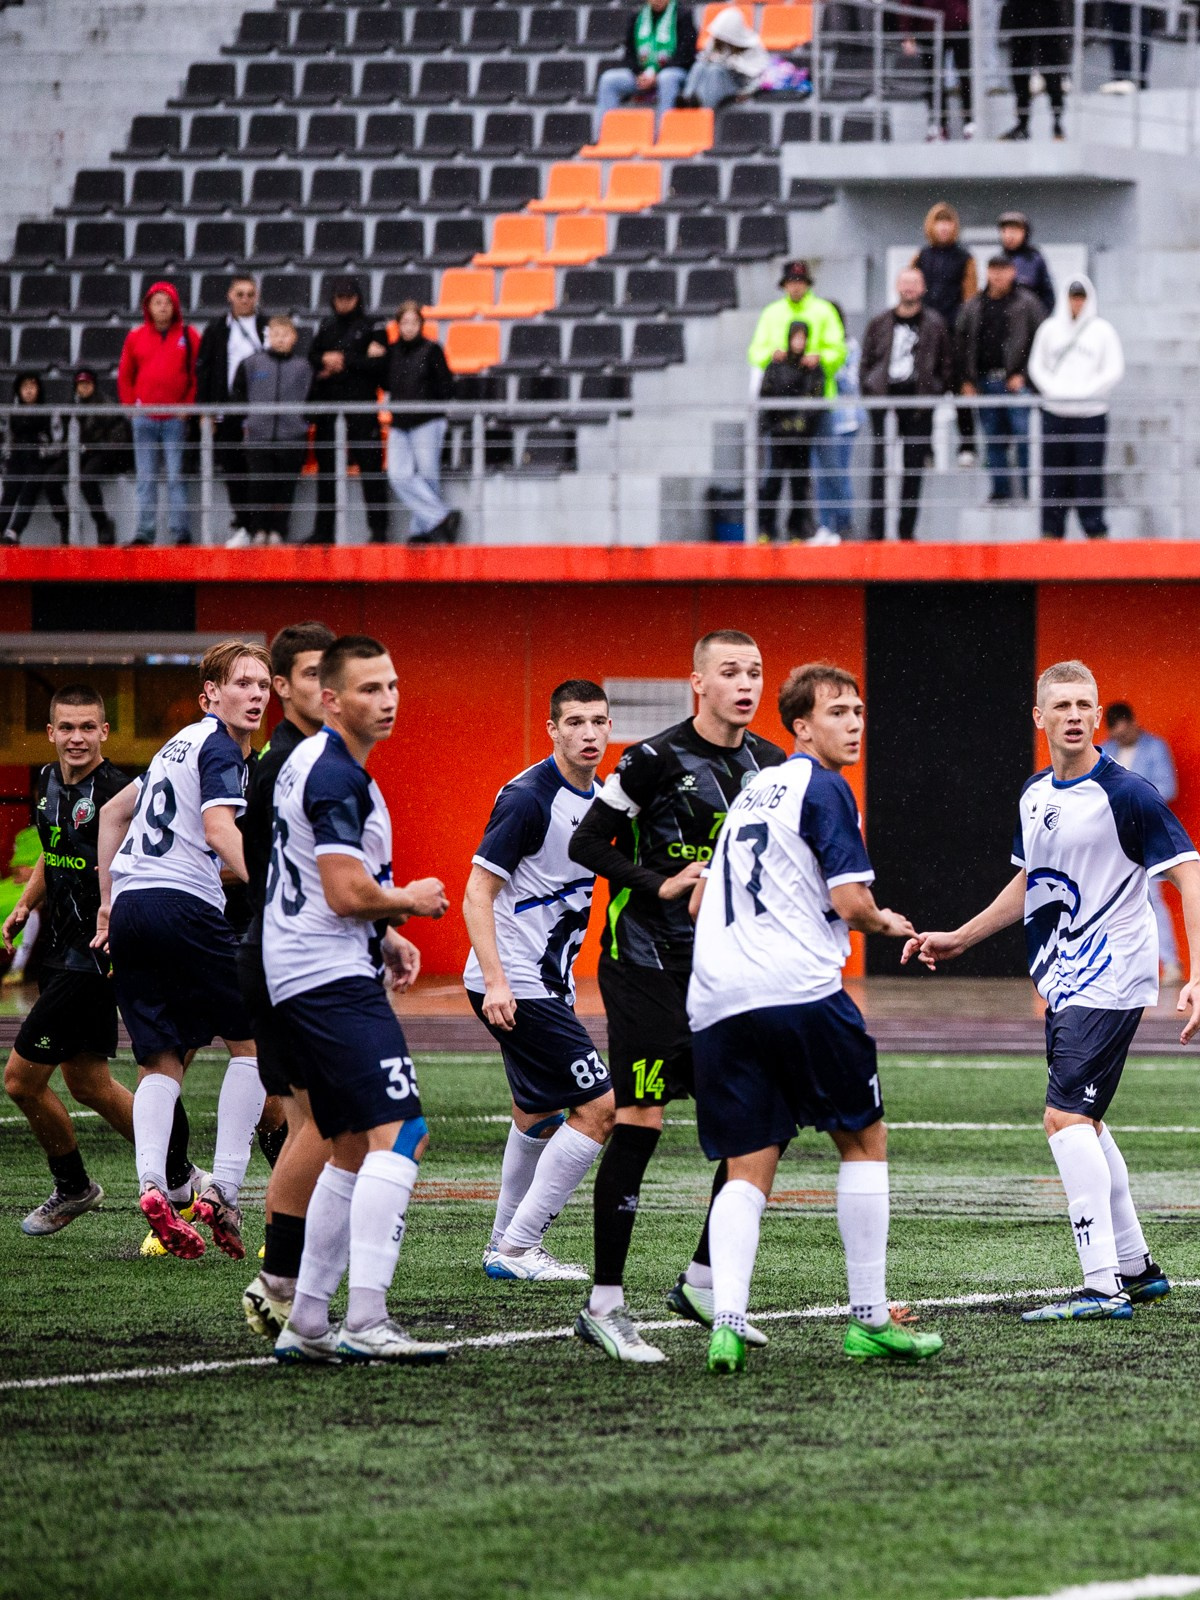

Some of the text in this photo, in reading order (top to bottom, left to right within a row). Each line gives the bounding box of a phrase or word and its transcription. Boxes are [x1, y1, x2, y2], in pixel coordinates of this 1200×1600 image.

[723, 822, 769, 927] 17
[571, 1050, 608, 1089] 83
[632, 1058, 665, 1100] 14
[1077, 1231, 1090, 1247] 11
